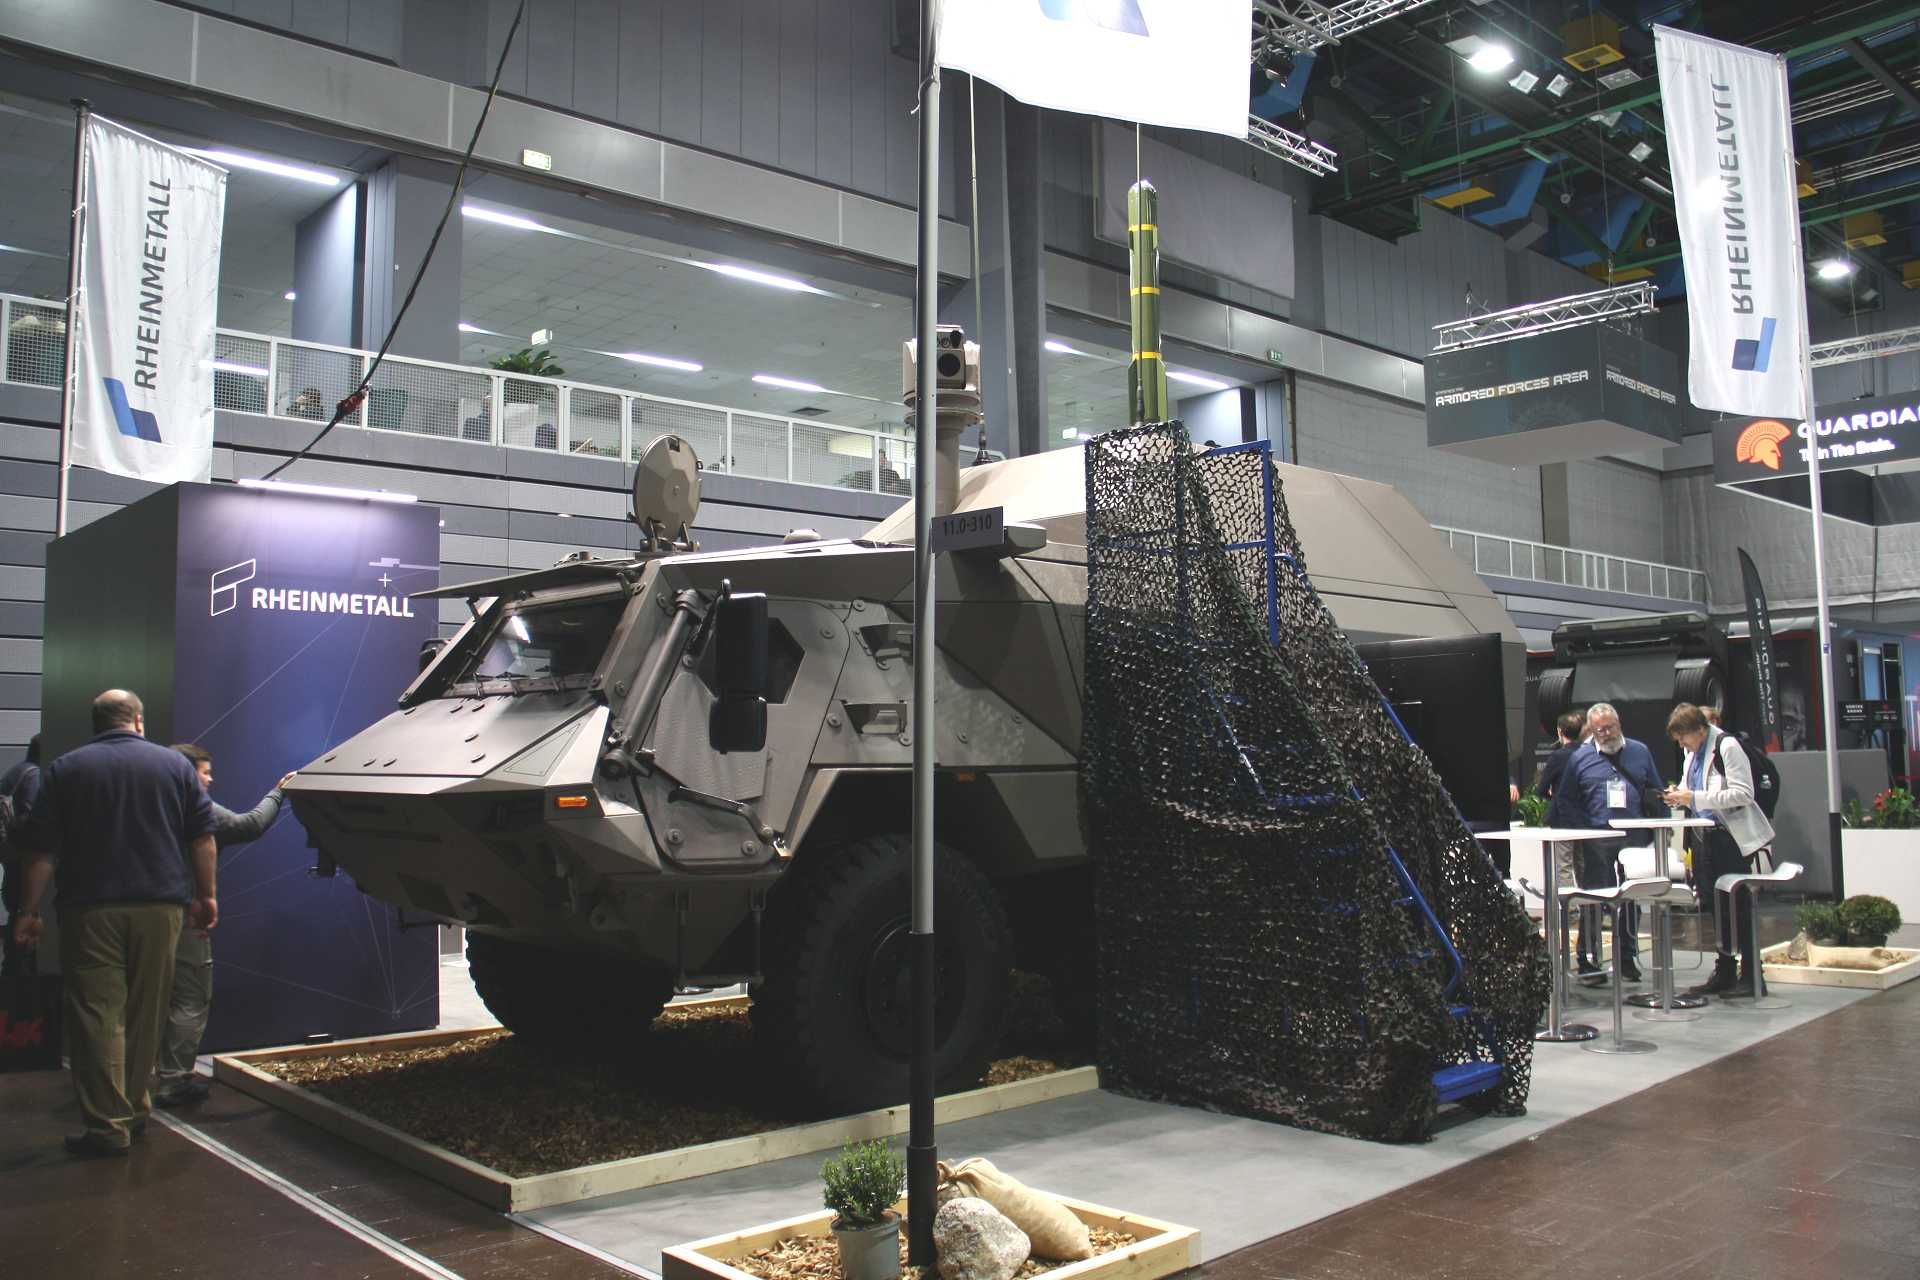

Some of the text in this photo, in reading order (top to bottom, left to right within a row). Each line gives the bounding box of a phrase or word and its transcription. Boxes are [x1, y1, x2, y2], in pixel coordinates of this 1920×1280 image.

[134, 178, 171, 390] RHEINMETALL
[1435, 387, 1494, 407] ARMORED
[1498, 377, 1550, 396] FORCES
[1553, 370, 1589, 386] AREA
[1830, 444, 1855, 457] The
[944, 514, 992, 537] 11.0-310
[252, 587, 414, 618] RHEINMETALL
